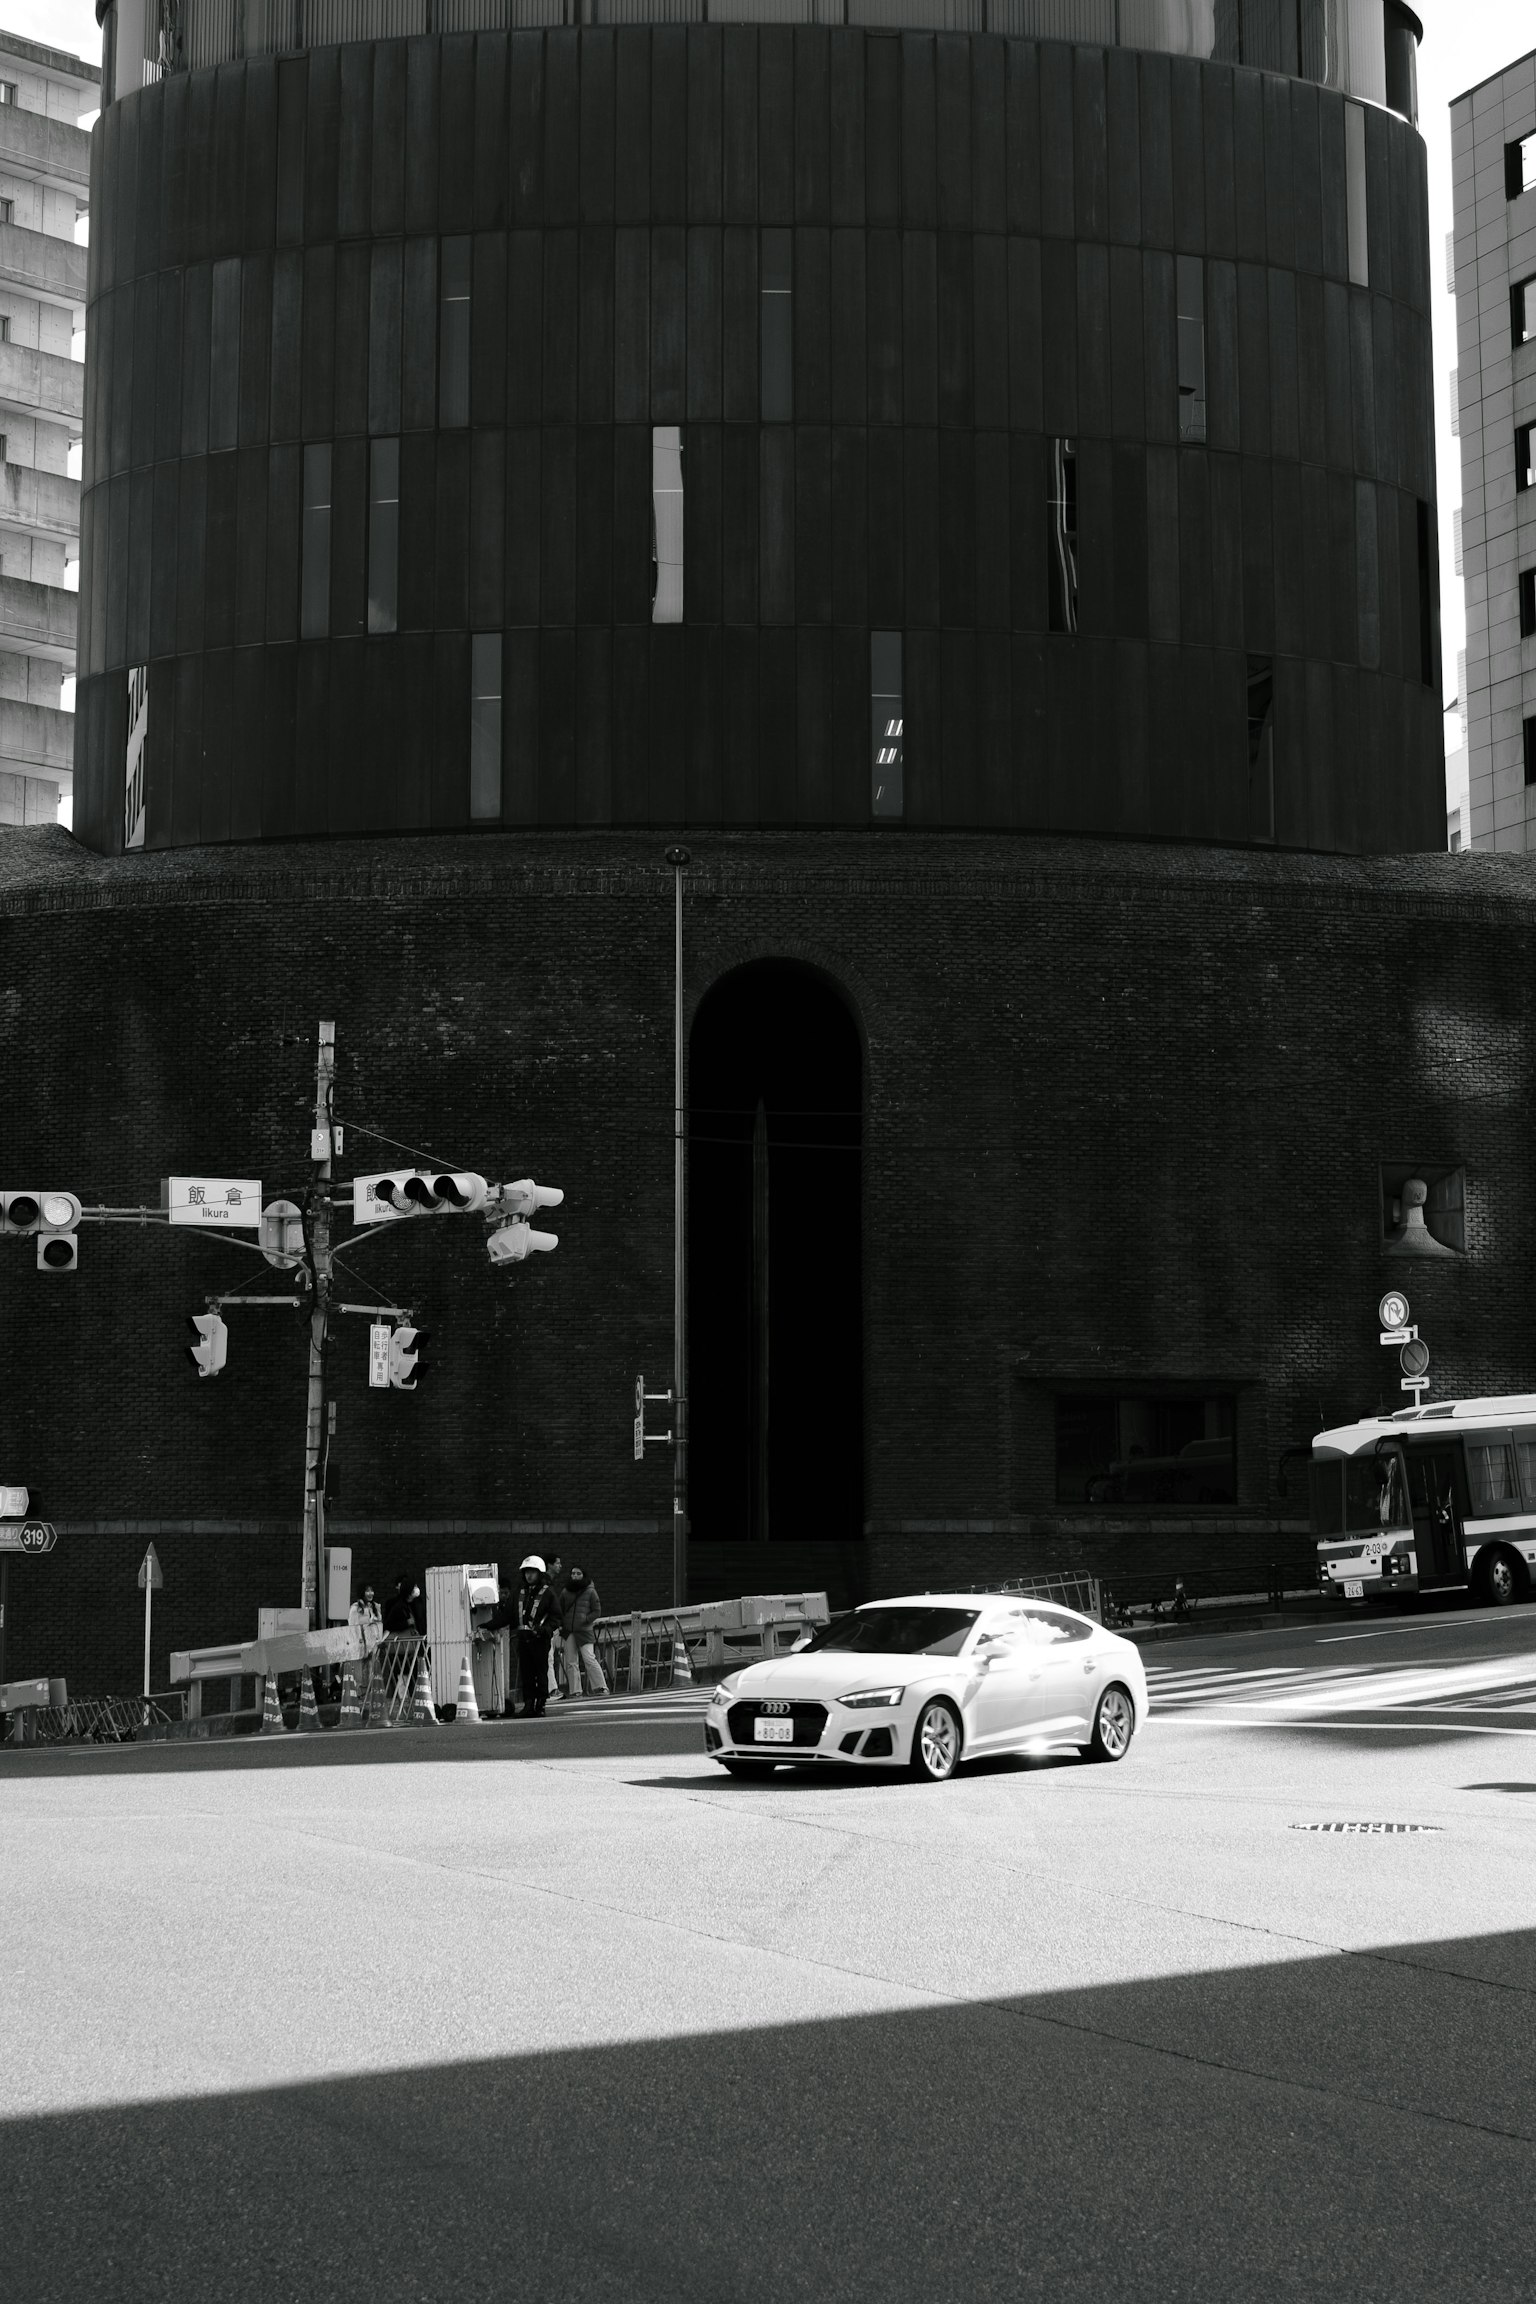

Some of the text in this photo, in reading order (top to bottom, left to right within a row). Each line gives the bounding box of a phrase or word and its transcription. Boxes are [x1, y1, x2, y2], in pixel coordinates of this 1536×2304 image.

[188, 1185, 243, 1206] 飯倉
[202, 1207, 229, 1218] Iikura
[23, 1529, 44, 1545] 319
[1365, 1543, 1381, 1556] 2-03
